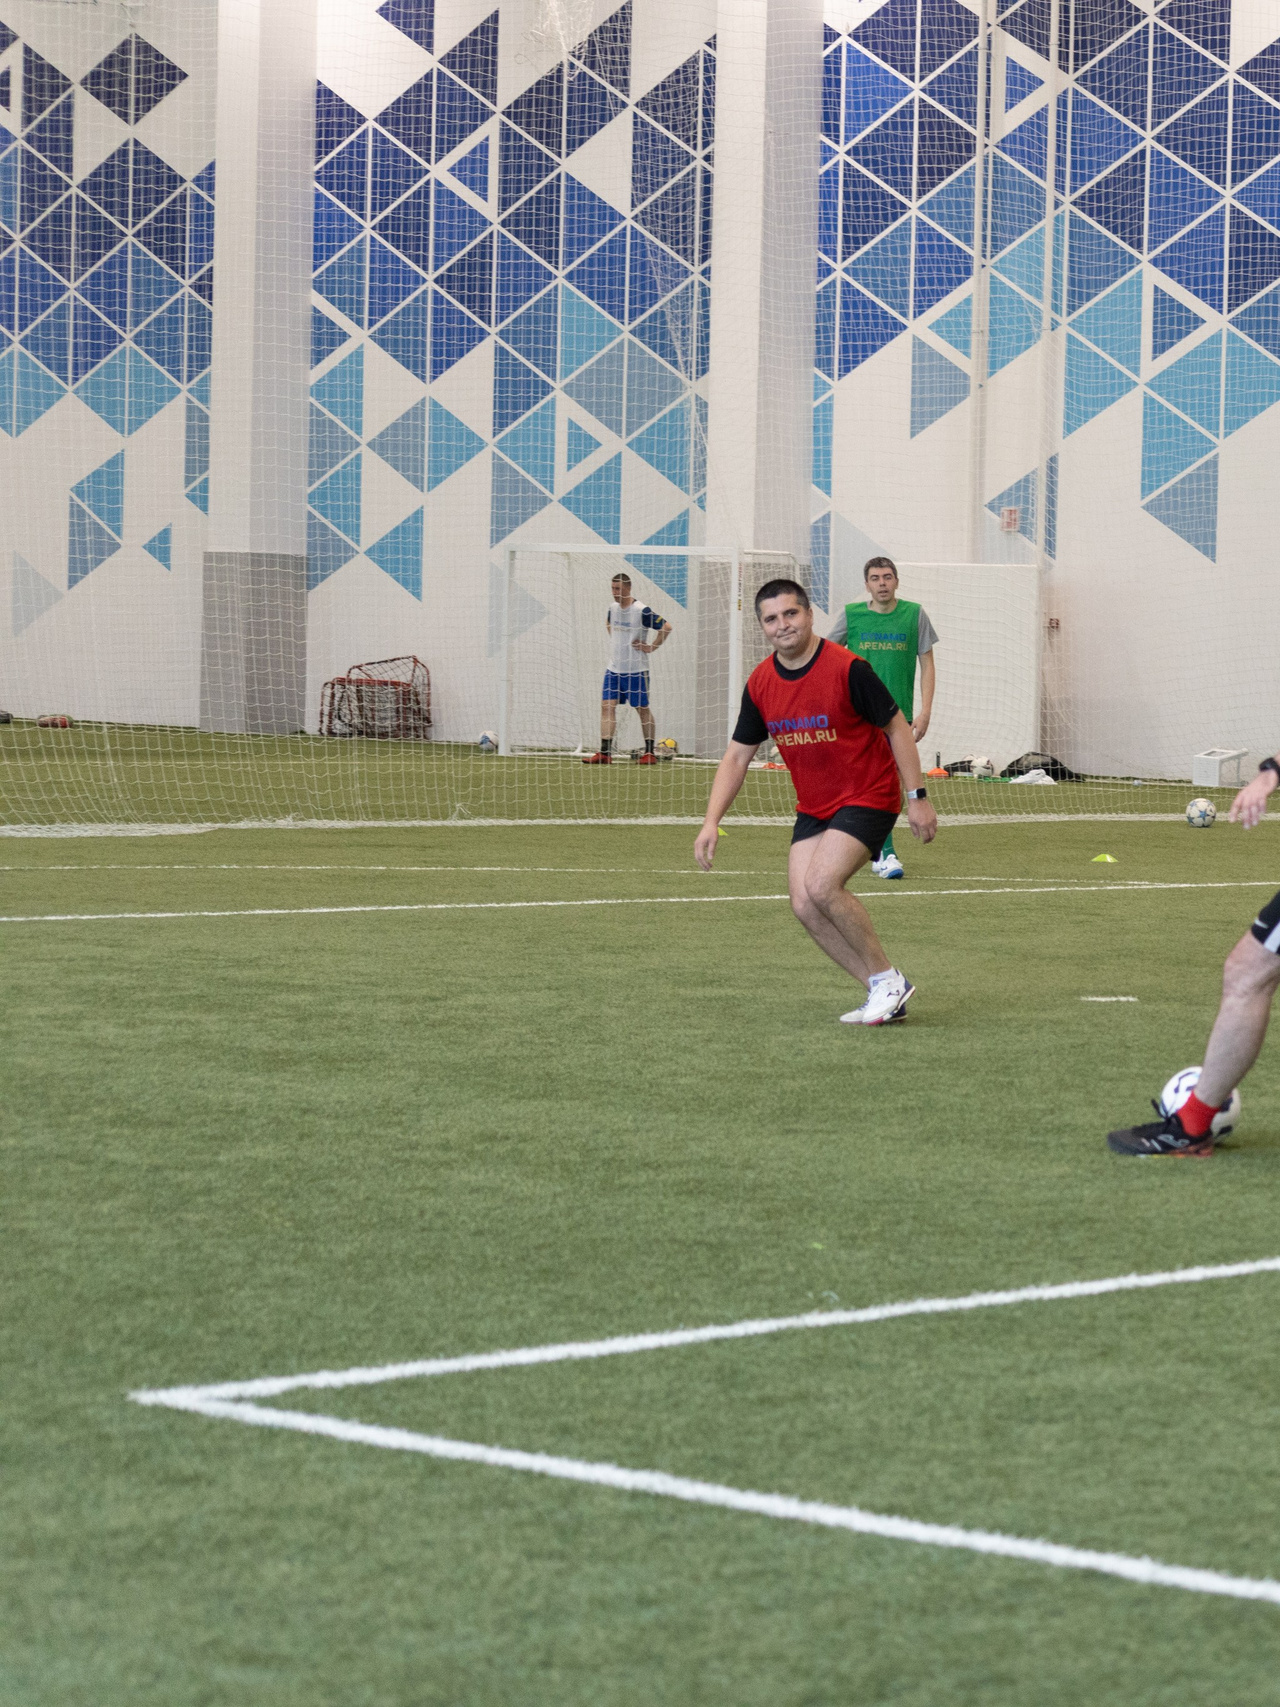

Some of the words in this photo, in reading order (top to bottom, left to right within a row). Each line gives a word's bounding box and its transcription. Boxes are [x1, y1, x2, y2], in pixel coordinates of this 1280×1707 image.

[860, 632, 907, 642] DYNAMO
[858, 641, 908, 651] ARENA.RU
[767, 714, 829, 734] DYNAMO
